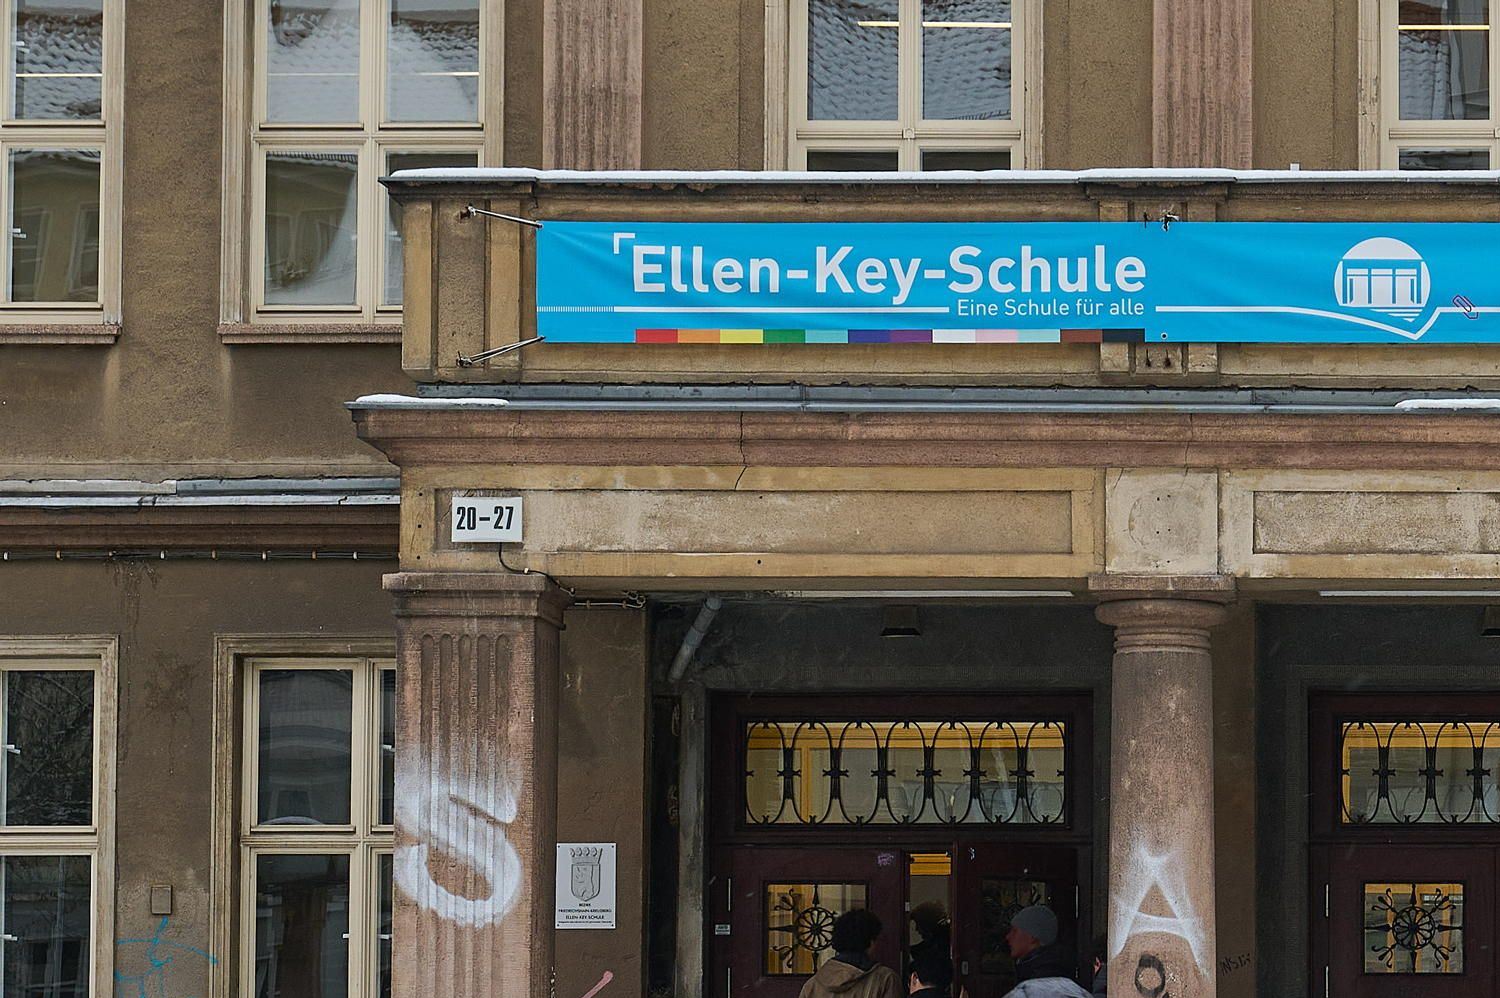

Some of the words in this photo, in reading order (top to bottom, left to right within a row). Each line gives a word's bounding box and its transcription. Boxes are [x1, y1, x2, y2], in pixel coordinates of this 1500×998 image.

[633, 245, 1147, 305] Ellen-Key-Schule
[957, 299, 998, 316] Eine
[1004, 298, 1069, 316] Schule
[1076, 298, 1104, 316] für
[1109, 298, 1144, 316] alle
[456, 505, 514, 531] 20-27
